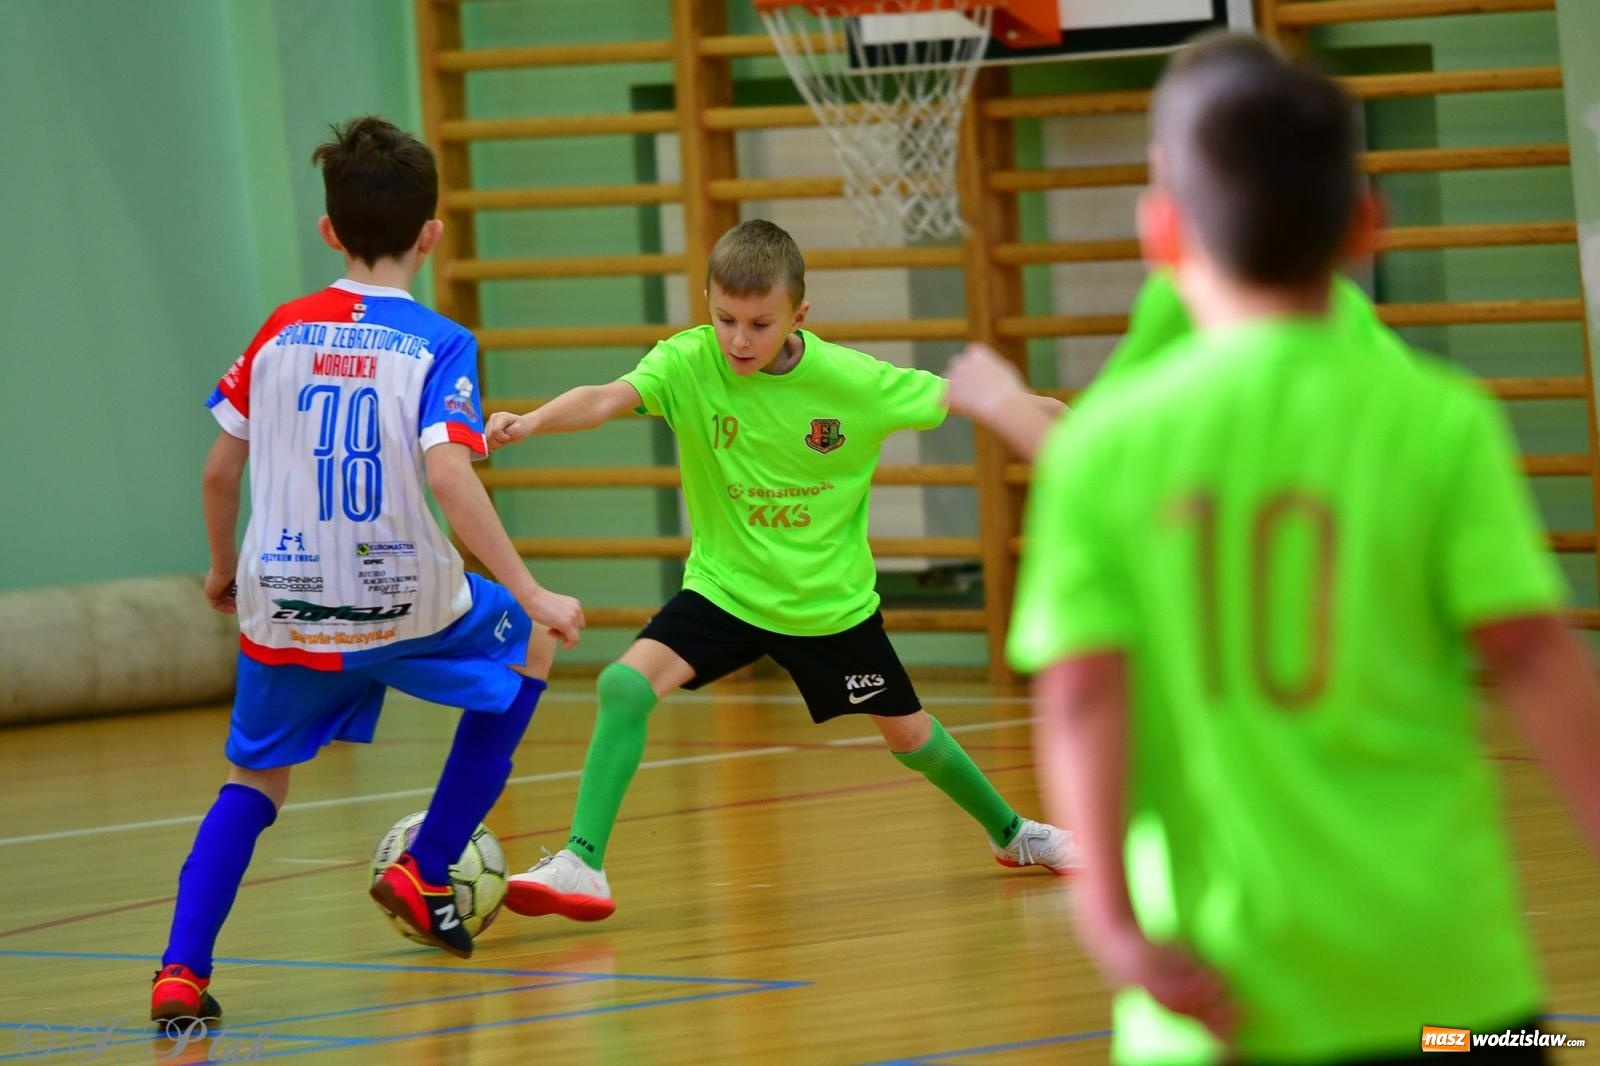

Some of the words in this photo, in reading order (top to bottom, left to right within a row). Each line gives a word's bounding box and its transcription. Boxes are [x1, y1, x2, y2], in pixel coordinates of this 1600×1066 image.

[712, 414, 739, 449] 19
[748, 504, 812, 528] KKS
[259, 574, 323, 583] MECHANIKA
[1155, 486, 1340, 710] 10
[845, 674, 885, 690] KKS
